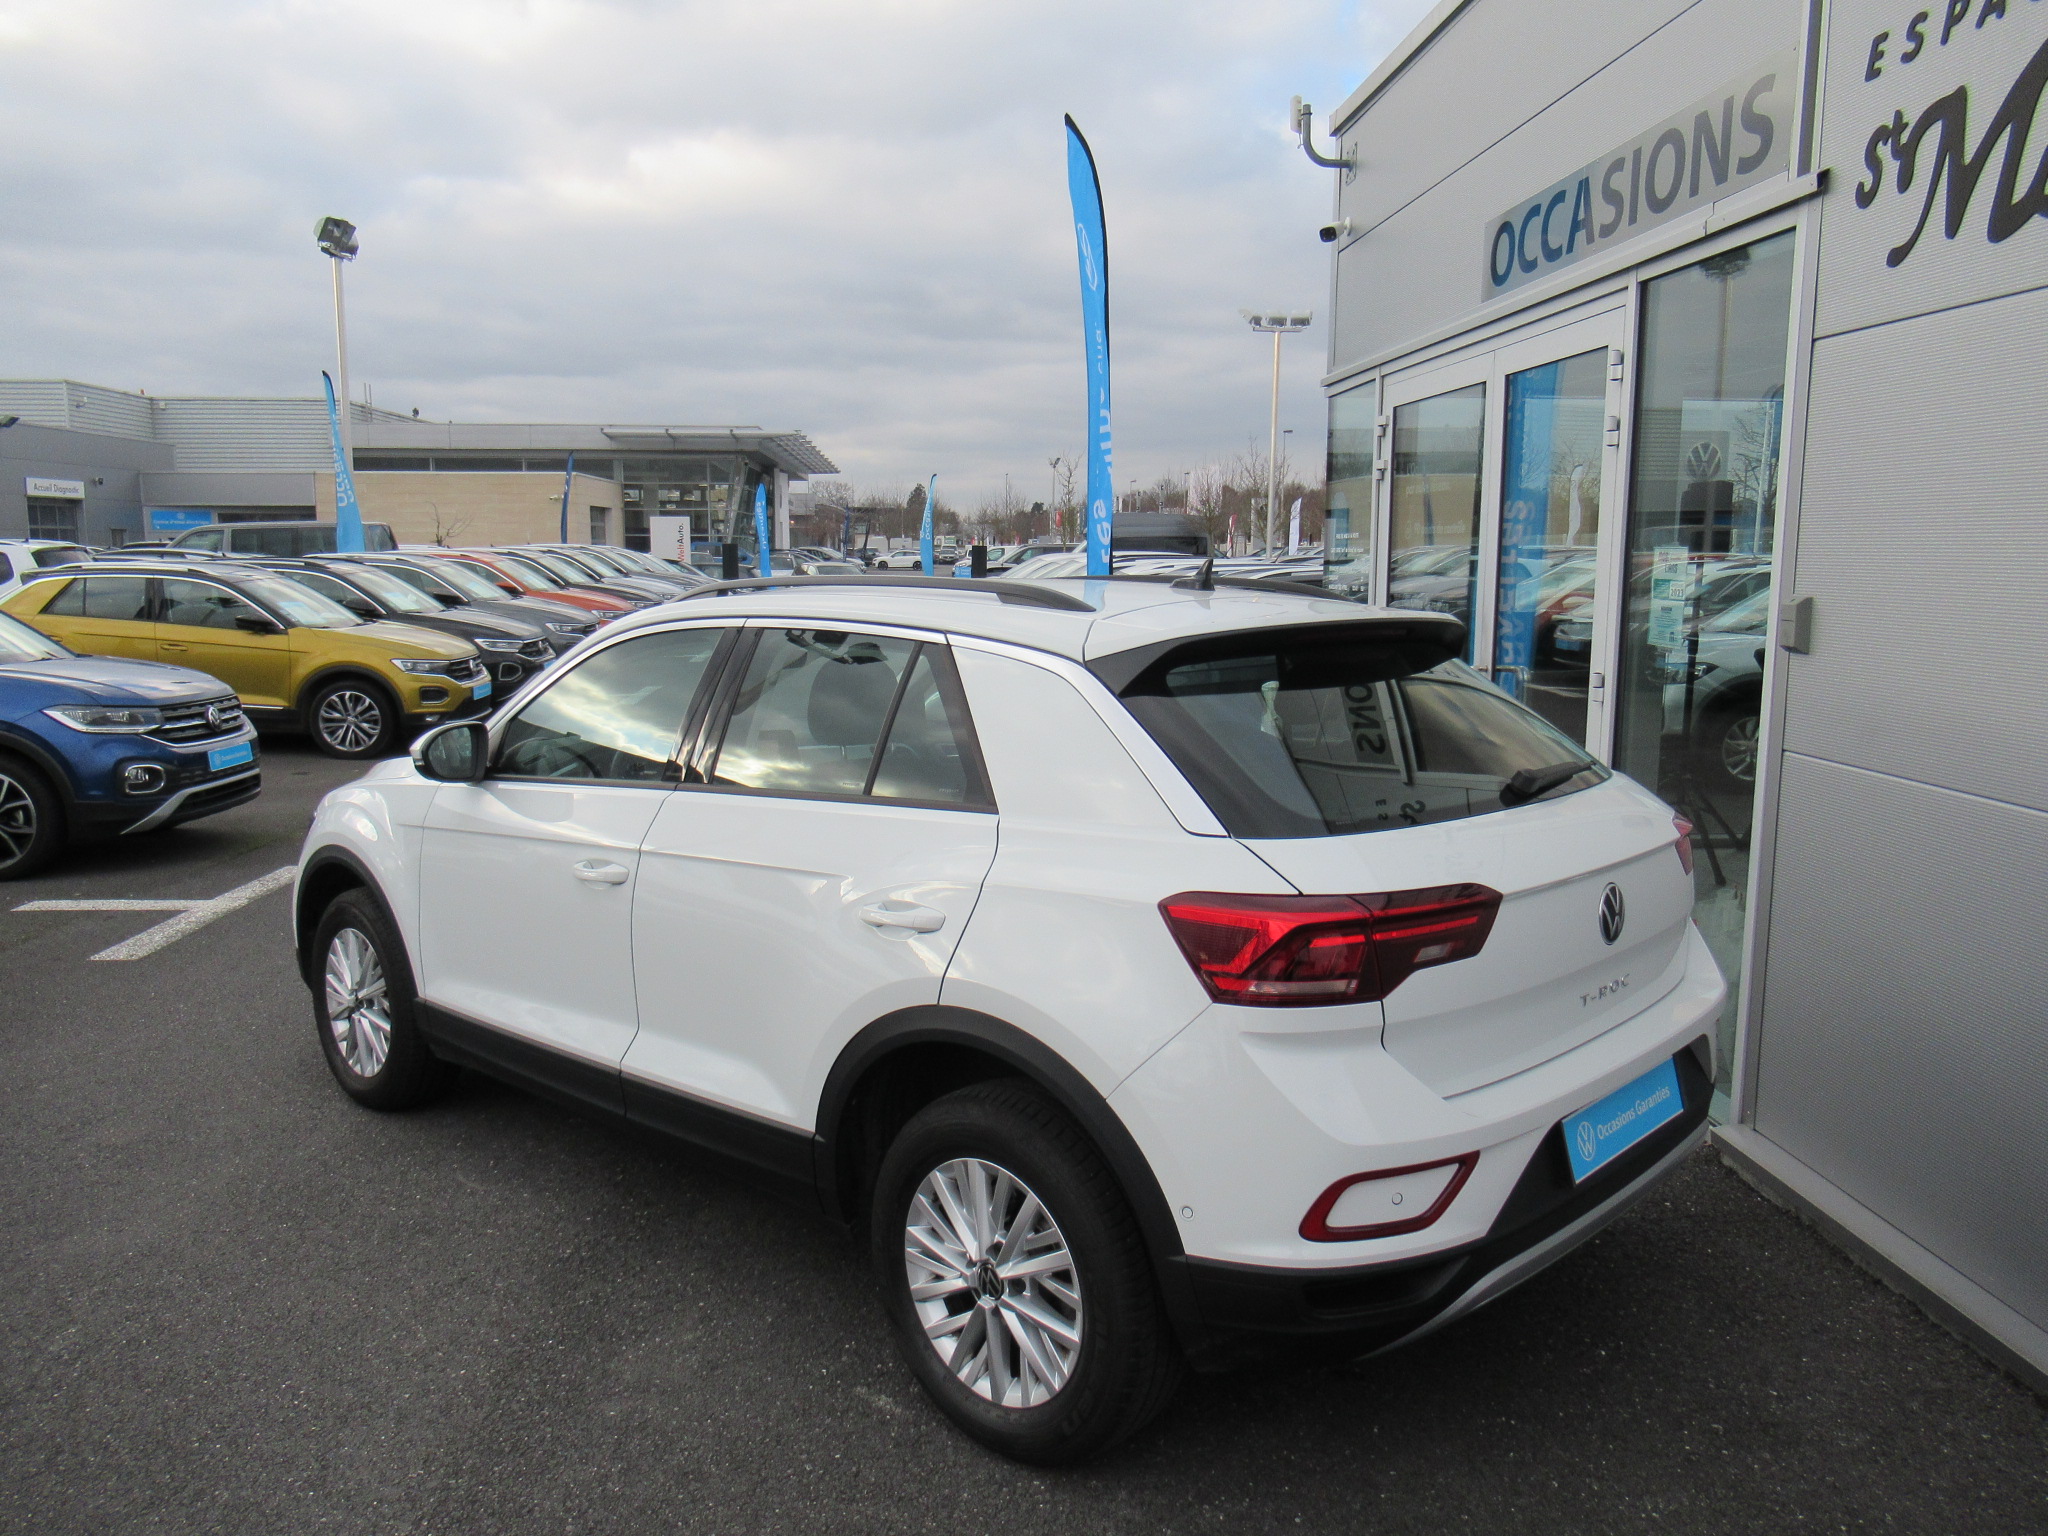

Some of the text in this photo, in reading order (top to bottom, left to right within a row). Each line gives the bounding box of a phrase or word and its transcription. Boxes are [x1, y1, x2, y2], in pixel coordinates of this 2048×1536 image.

[1864, 0, 2042, 82] ESPA
[1491, 74, 1777, 288] OCCASIONS
[34, 482, 80, 495] Accueil Diagnostic
[1580, 974, 1630, 1008] T-ROC
[1597, 1108, 1636, 1140] Occasions
[1635, 1086, 1670, 1115] Garanties
